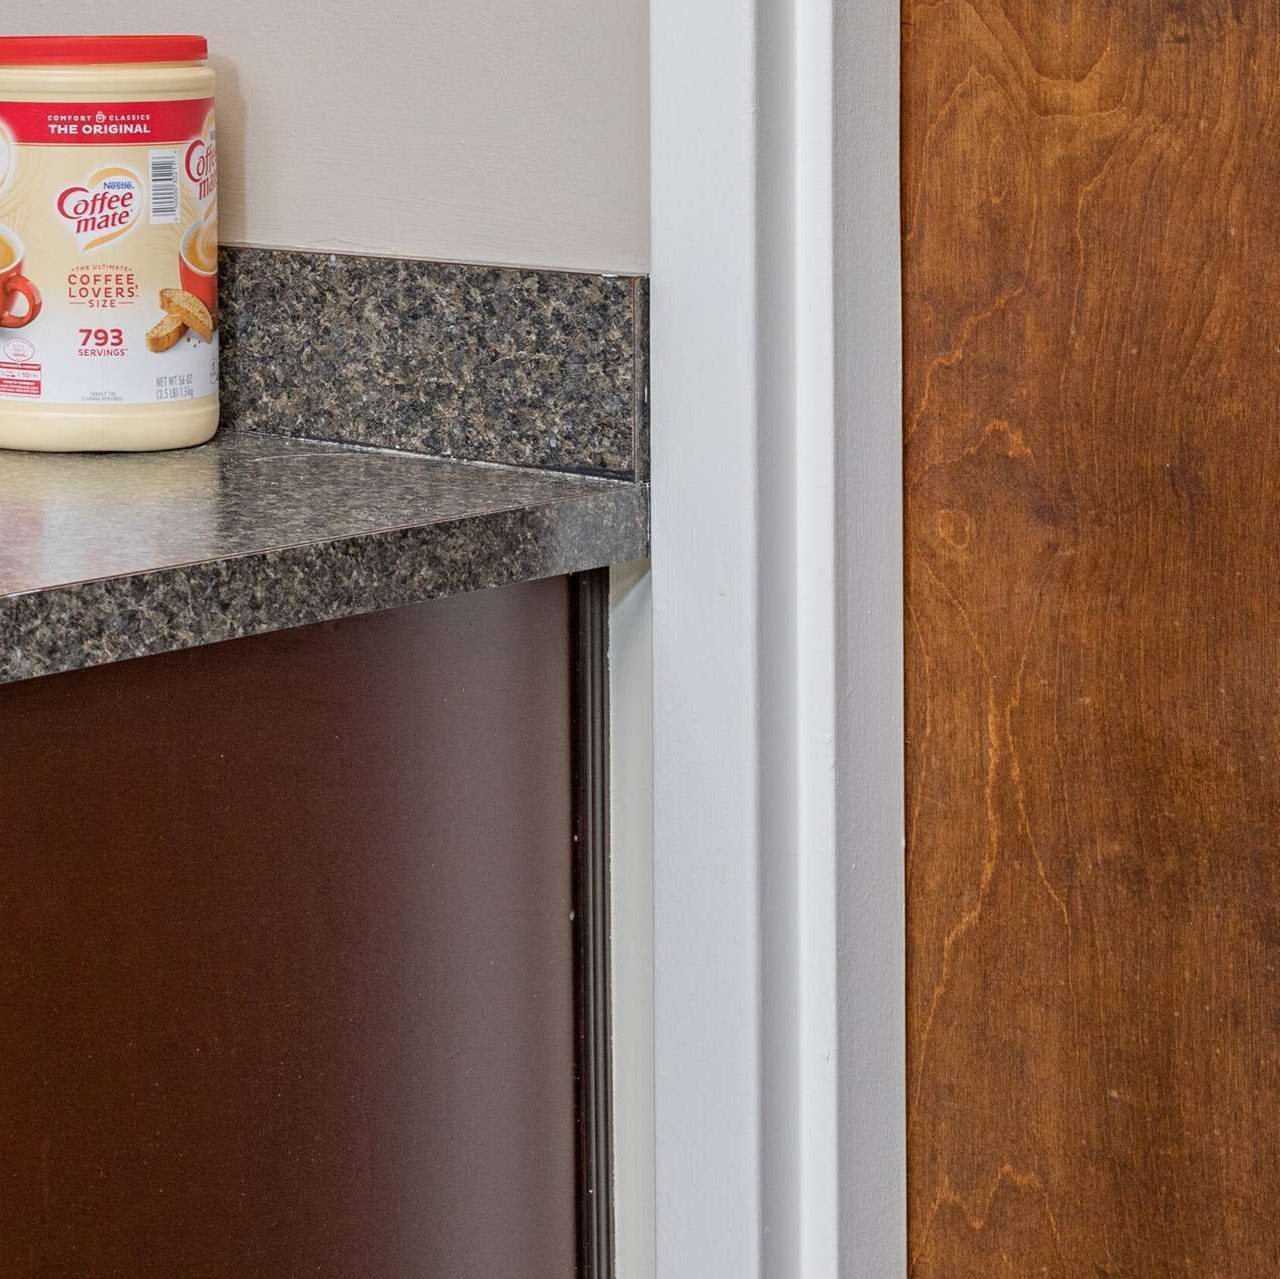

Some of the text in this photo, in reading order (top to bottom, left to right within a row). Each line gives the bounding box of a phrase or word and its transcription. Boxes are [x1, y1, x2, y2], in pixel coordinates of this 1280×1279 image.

[48, 123, 151, 134] THE ORIGINAL
[57, 186, 133, 219] Coffee
[75, 210, 129, 233] mate
[92, 264, 129, 272] ULTIMATE
[67, 274, 135, 285] COFFEE
[88, 299, 116, 308] SIZE
[79, 328, 123, 346] 793
